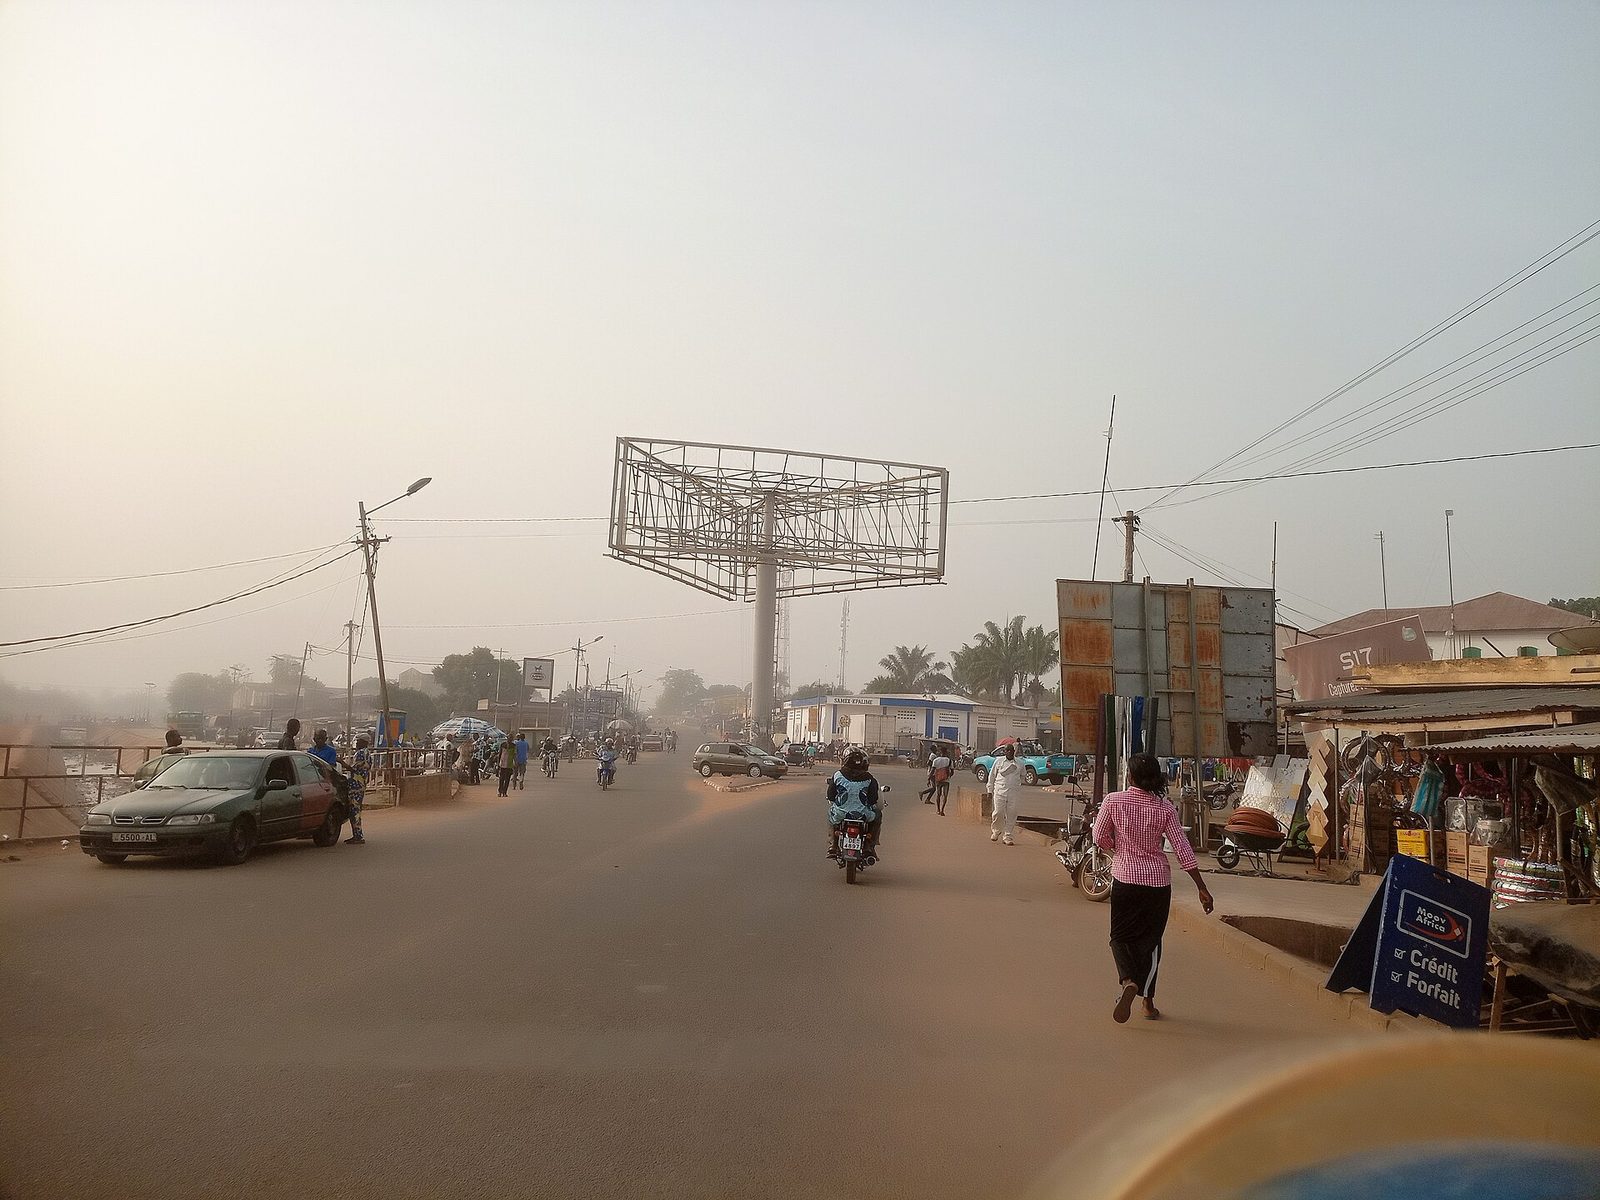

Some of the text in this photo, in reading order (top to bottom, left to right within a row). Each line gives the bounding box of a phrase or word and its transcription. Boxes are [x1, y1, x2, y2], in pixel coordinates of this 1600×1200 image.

[1416, 914, 1446, 933] Africa
[1417, 906, 1447, 924] Moov
[1410, 949, 1458, 984] Crédit
[1406, 970, 1461, 1009] Forfait
